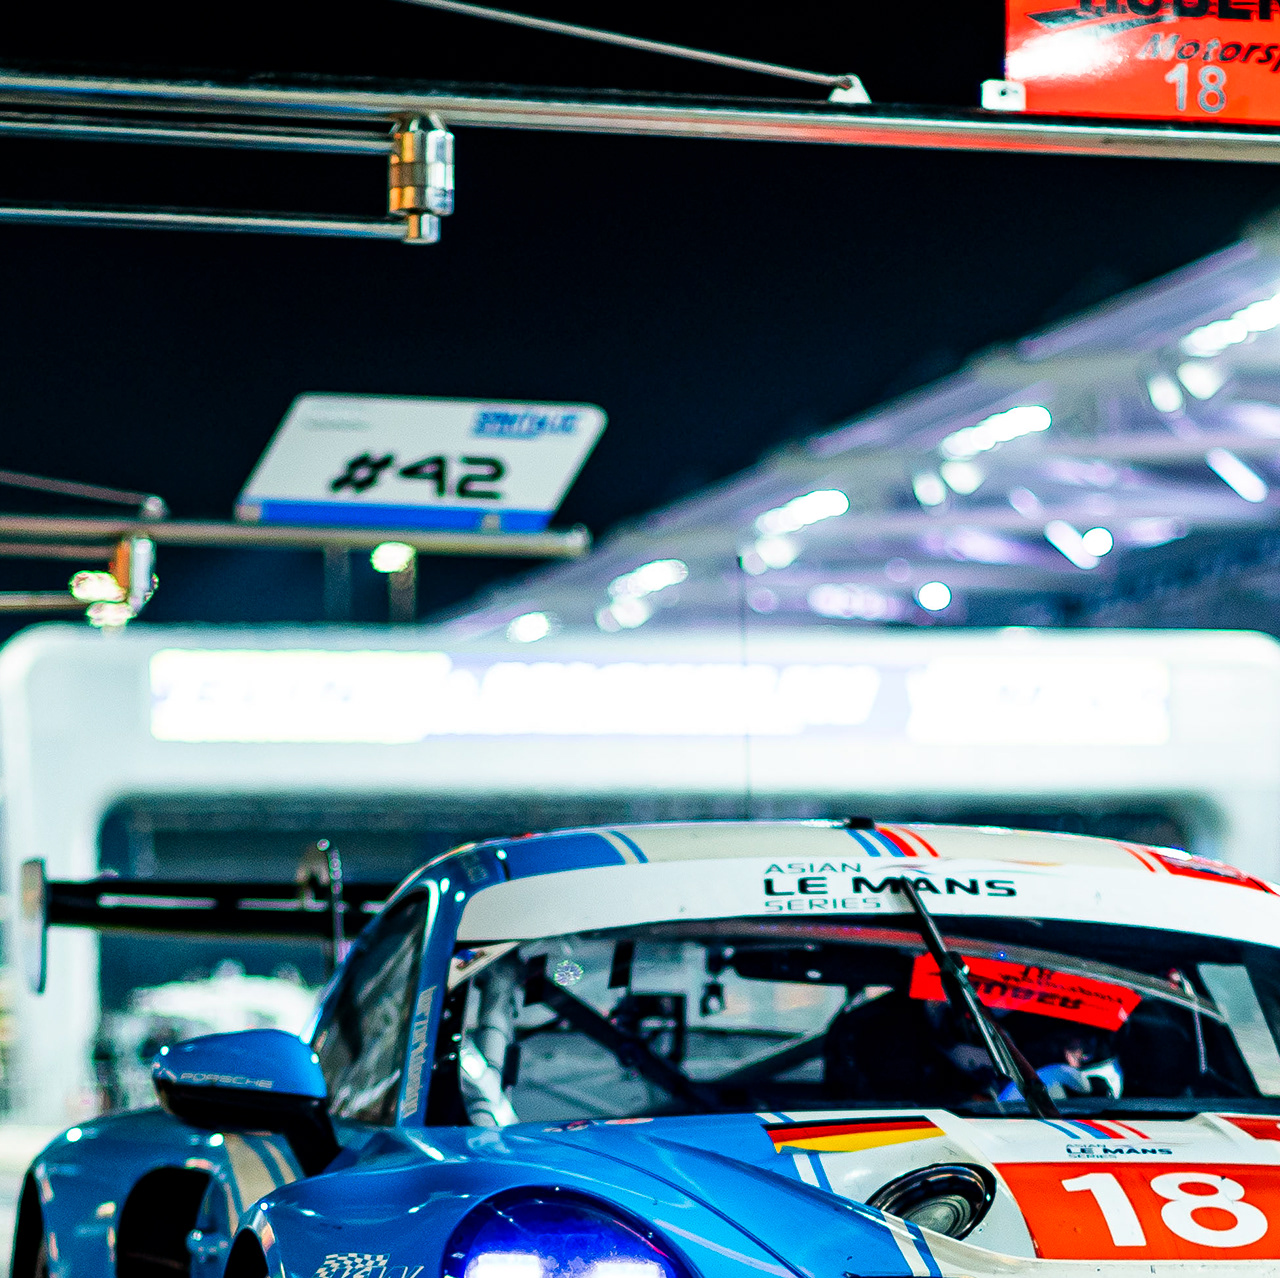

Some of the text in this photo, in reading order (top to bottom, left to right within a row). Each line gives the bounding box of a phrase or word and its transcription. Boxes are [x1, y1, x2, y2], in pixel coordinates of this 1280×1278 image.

[1165, 63, 1227, 112] 18
[330, 453, 505, 500] #42
[764, 862, 862, 875] ASIAN
[764, 876, 1018, 898] LE MANS
[764, 897, 882, 912] SERIES
[1061, 1171, 1269, 1248] 18
